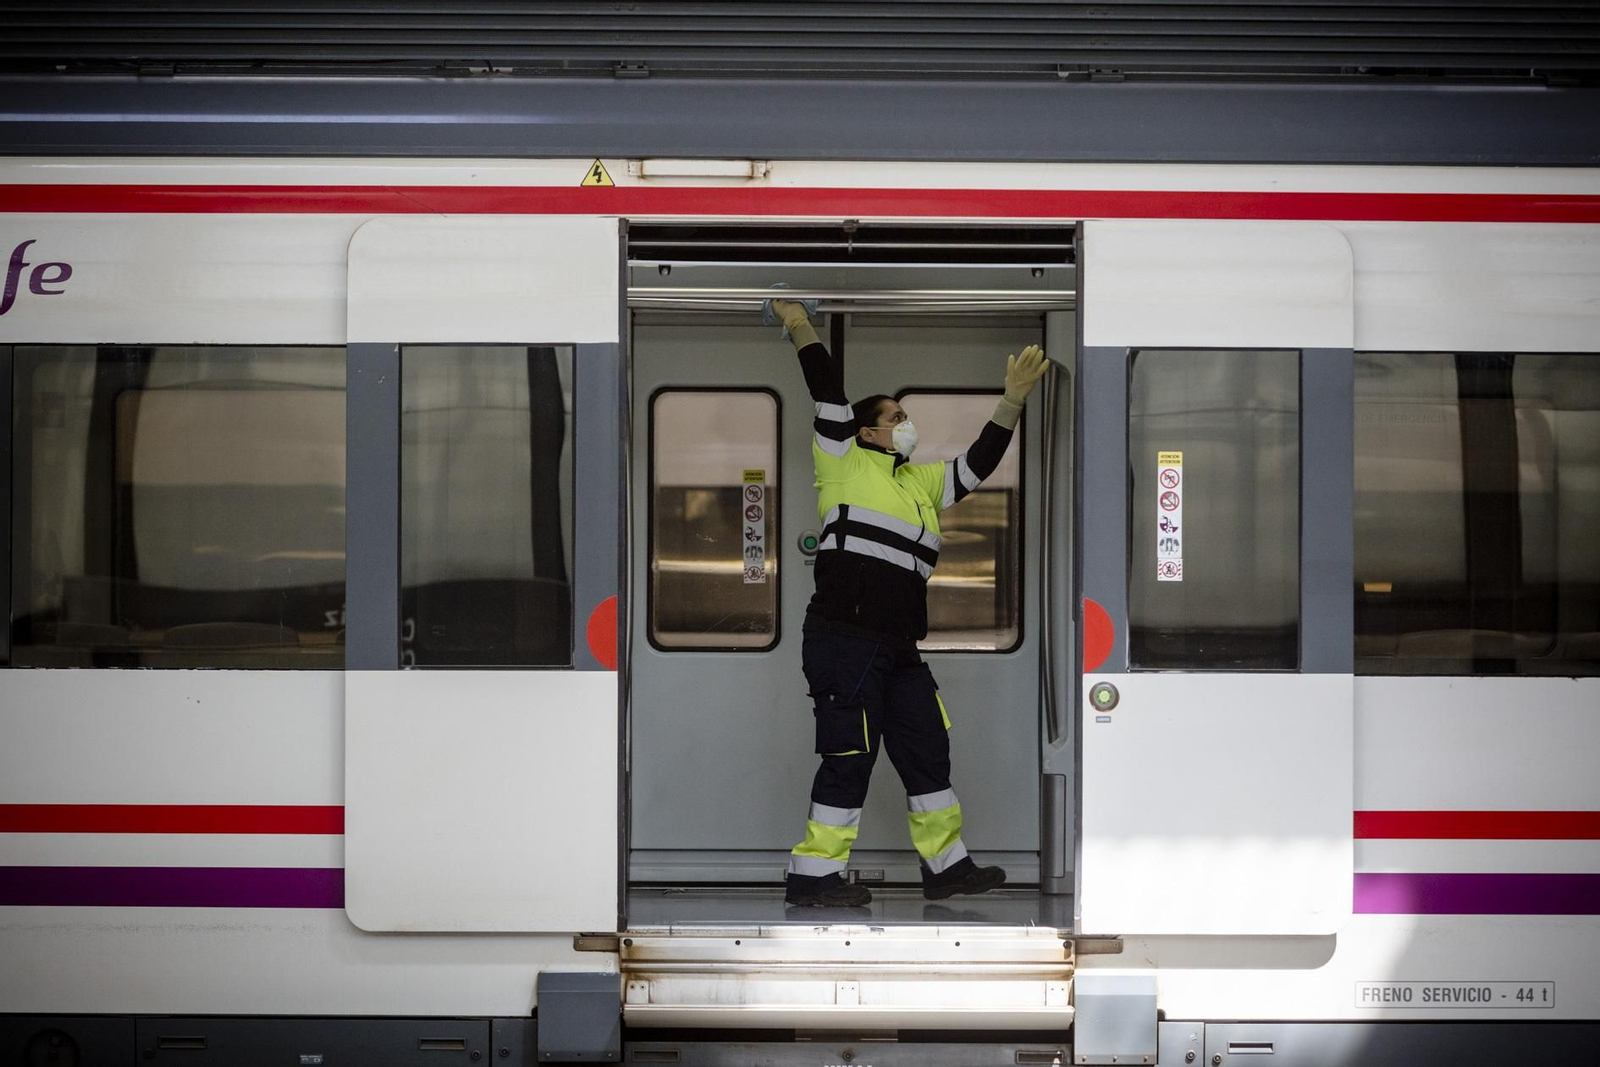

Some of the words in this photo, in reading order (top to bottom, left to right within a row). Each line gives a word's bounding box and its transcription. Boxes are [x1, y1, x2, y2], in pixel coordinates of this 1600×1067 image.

[0, 239, 73, 315] fe
[1362, 987, 1413, 1003] FRENO
[1422, 987, 1492, 1003] SERVICIO
[1515, 987, 1535, 1002] 44
[1542, 987, 1548, 1002] t
